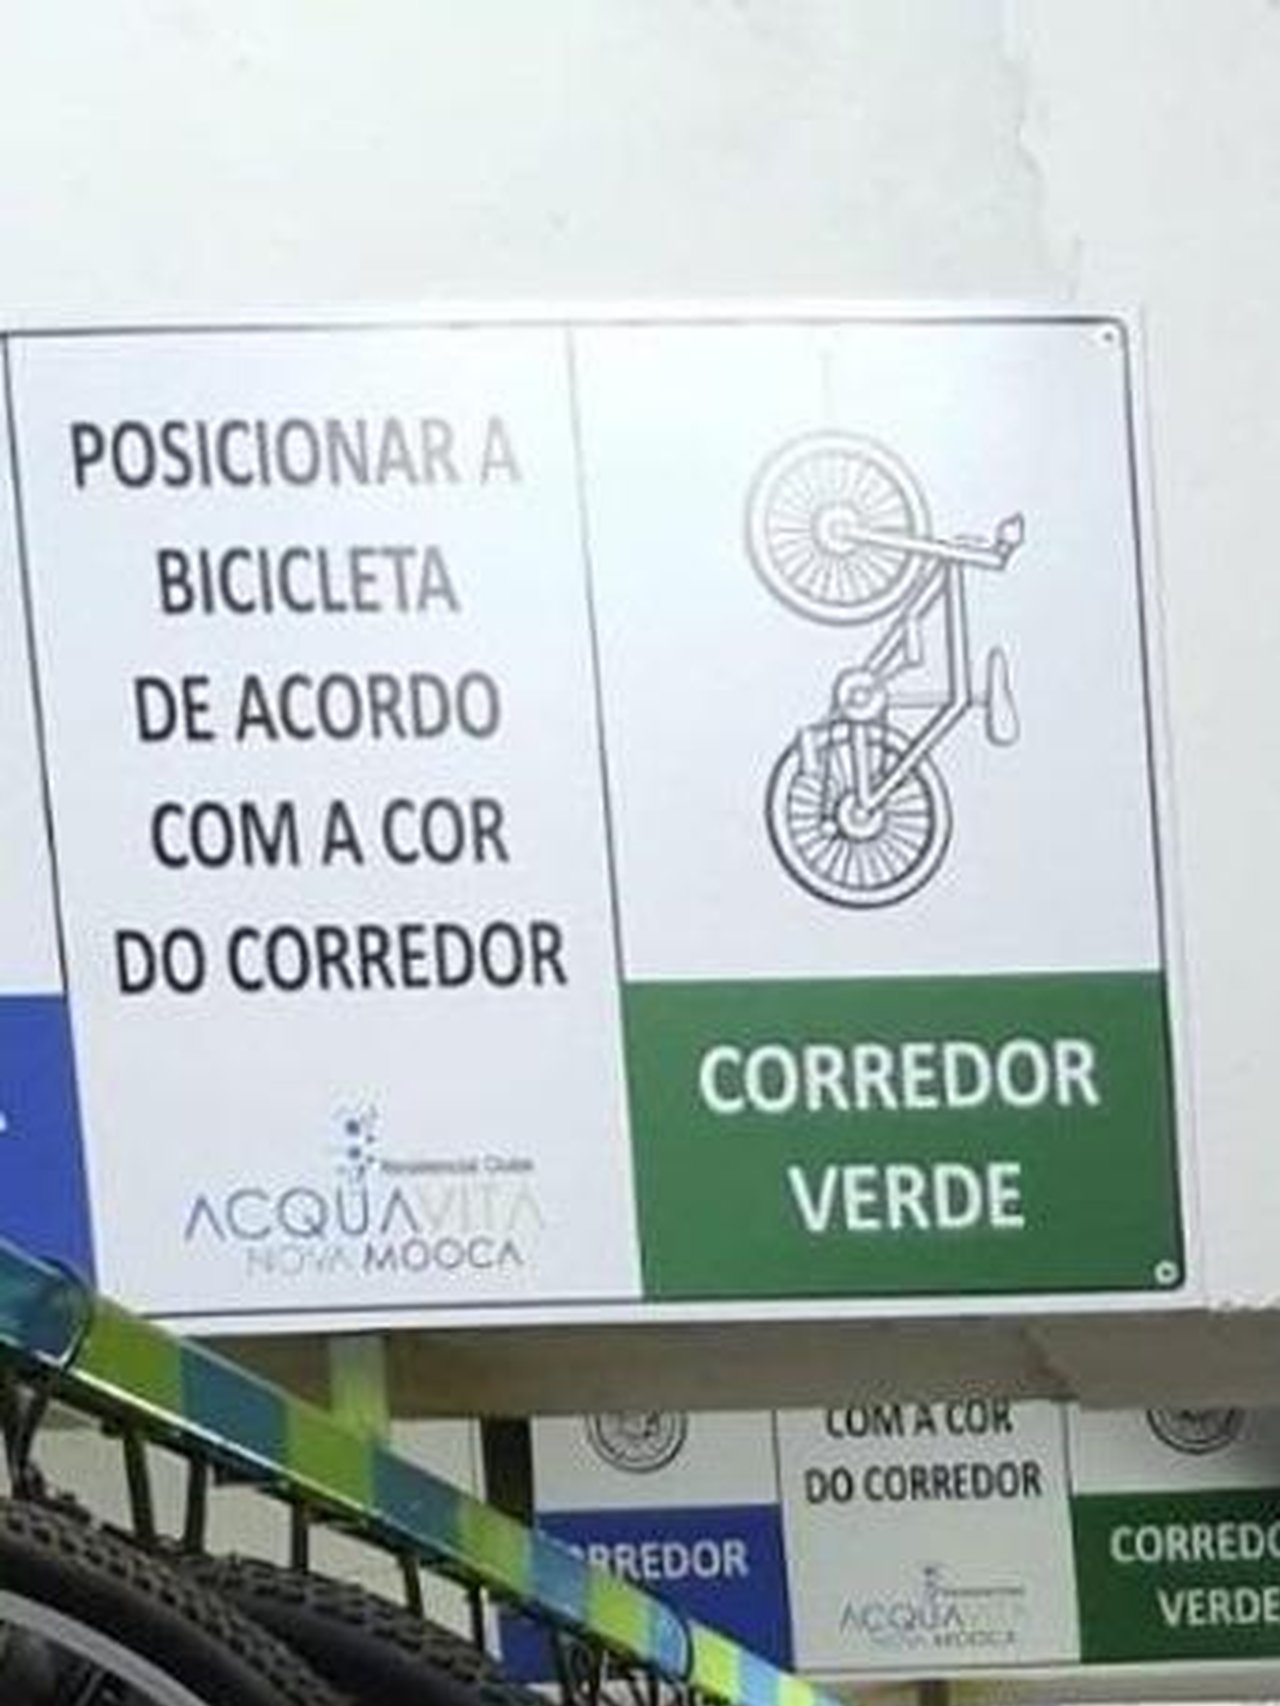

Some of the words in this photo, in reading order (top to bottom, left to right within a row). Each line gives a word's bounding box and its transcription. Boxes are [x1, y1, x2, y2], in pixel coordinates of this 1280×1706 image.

[71, 419, 461, 488] POSICIONAR
[480, 417, 522, 483] A
[156, 545, 462, 615] BICICLETA
[135, 676, 216, 743] DE
[234, 671, 503, 742] ACORDO
[151, 800, 299, 869] COM
[321, 801, 365, 866] A
[381, 798, 510, 866] COR
[114, 927, 203, 996] DO
[228, 920, 569, 993] CORREDOR
[698, 1038, 1101, 1114] CORREDOR
[789, 1161, 1026, 1235] VERDE
[246, 1244, 352, 1276] NOVA
[363, 1237, 525, 1274] MOOCA
[826, 1403, 904, 1438] COM
[914, 1402, 937, 1436] A
[946, 1399, 1014, 1435] COR
[805, 1466, 854, 1504] DO
[863, 1460, 1043, 1502] CORREDOR
[565, 1538, 750, 1580] RREDOR
